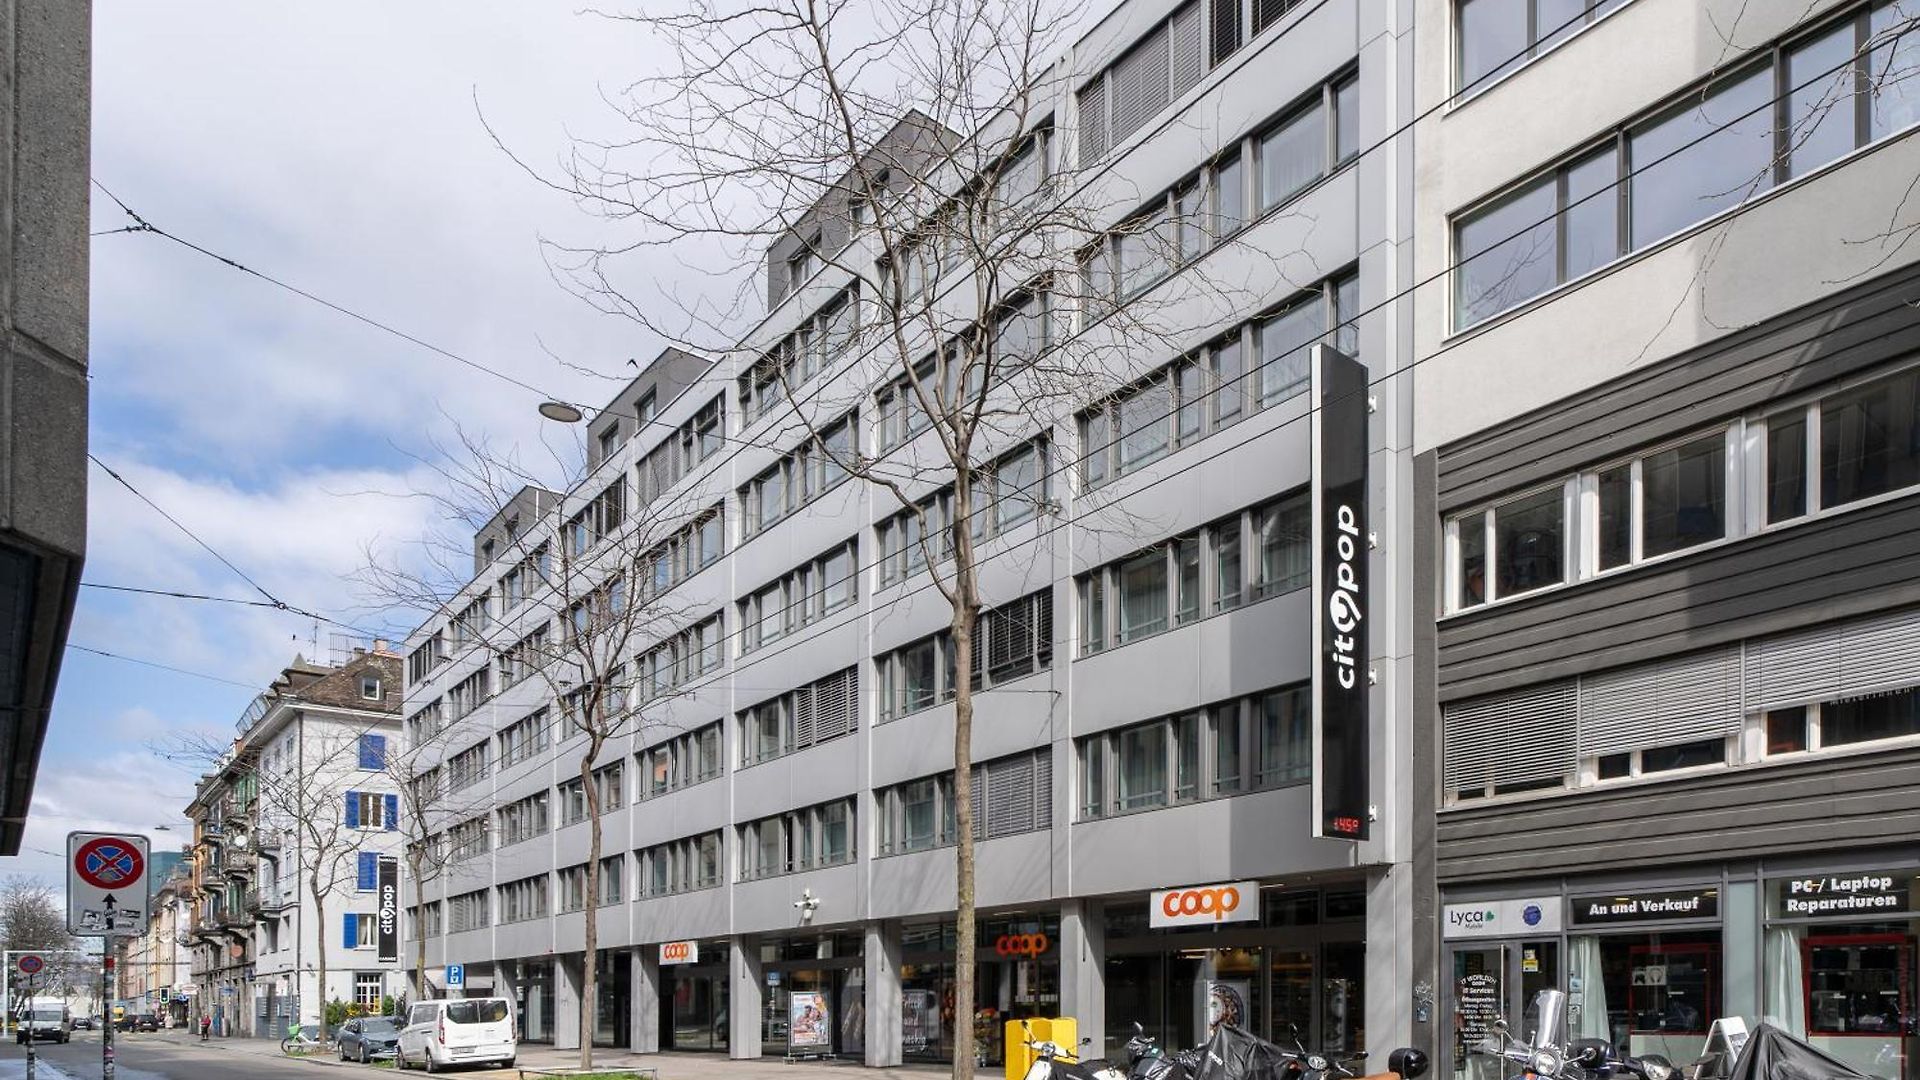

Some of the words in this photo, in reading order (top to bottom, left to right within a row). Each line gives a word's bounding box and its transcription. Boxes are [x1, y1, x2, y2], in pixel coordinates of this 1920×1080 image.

[1330, 504, 1362, 690] citypop
[1791, 880, 1813, 893] PC
[1831, 876, 1893, 892] Laptop
[380, 884, 396, 934] citypop
[1163, 887, 1240, 921] coop
[1589, 903, 1607, 915] An
[1611, 900, 1637, 914] und
[1640, 896, 1699, 912] Verkauf
[1787, 895, 1897, 914] Reparaturen
[1450, 910, 1483, 926] Lyca
[665, 943, 689, 961] coop
[996, 933, 1047, 959] coop
[451, 966, 459, 976] P
